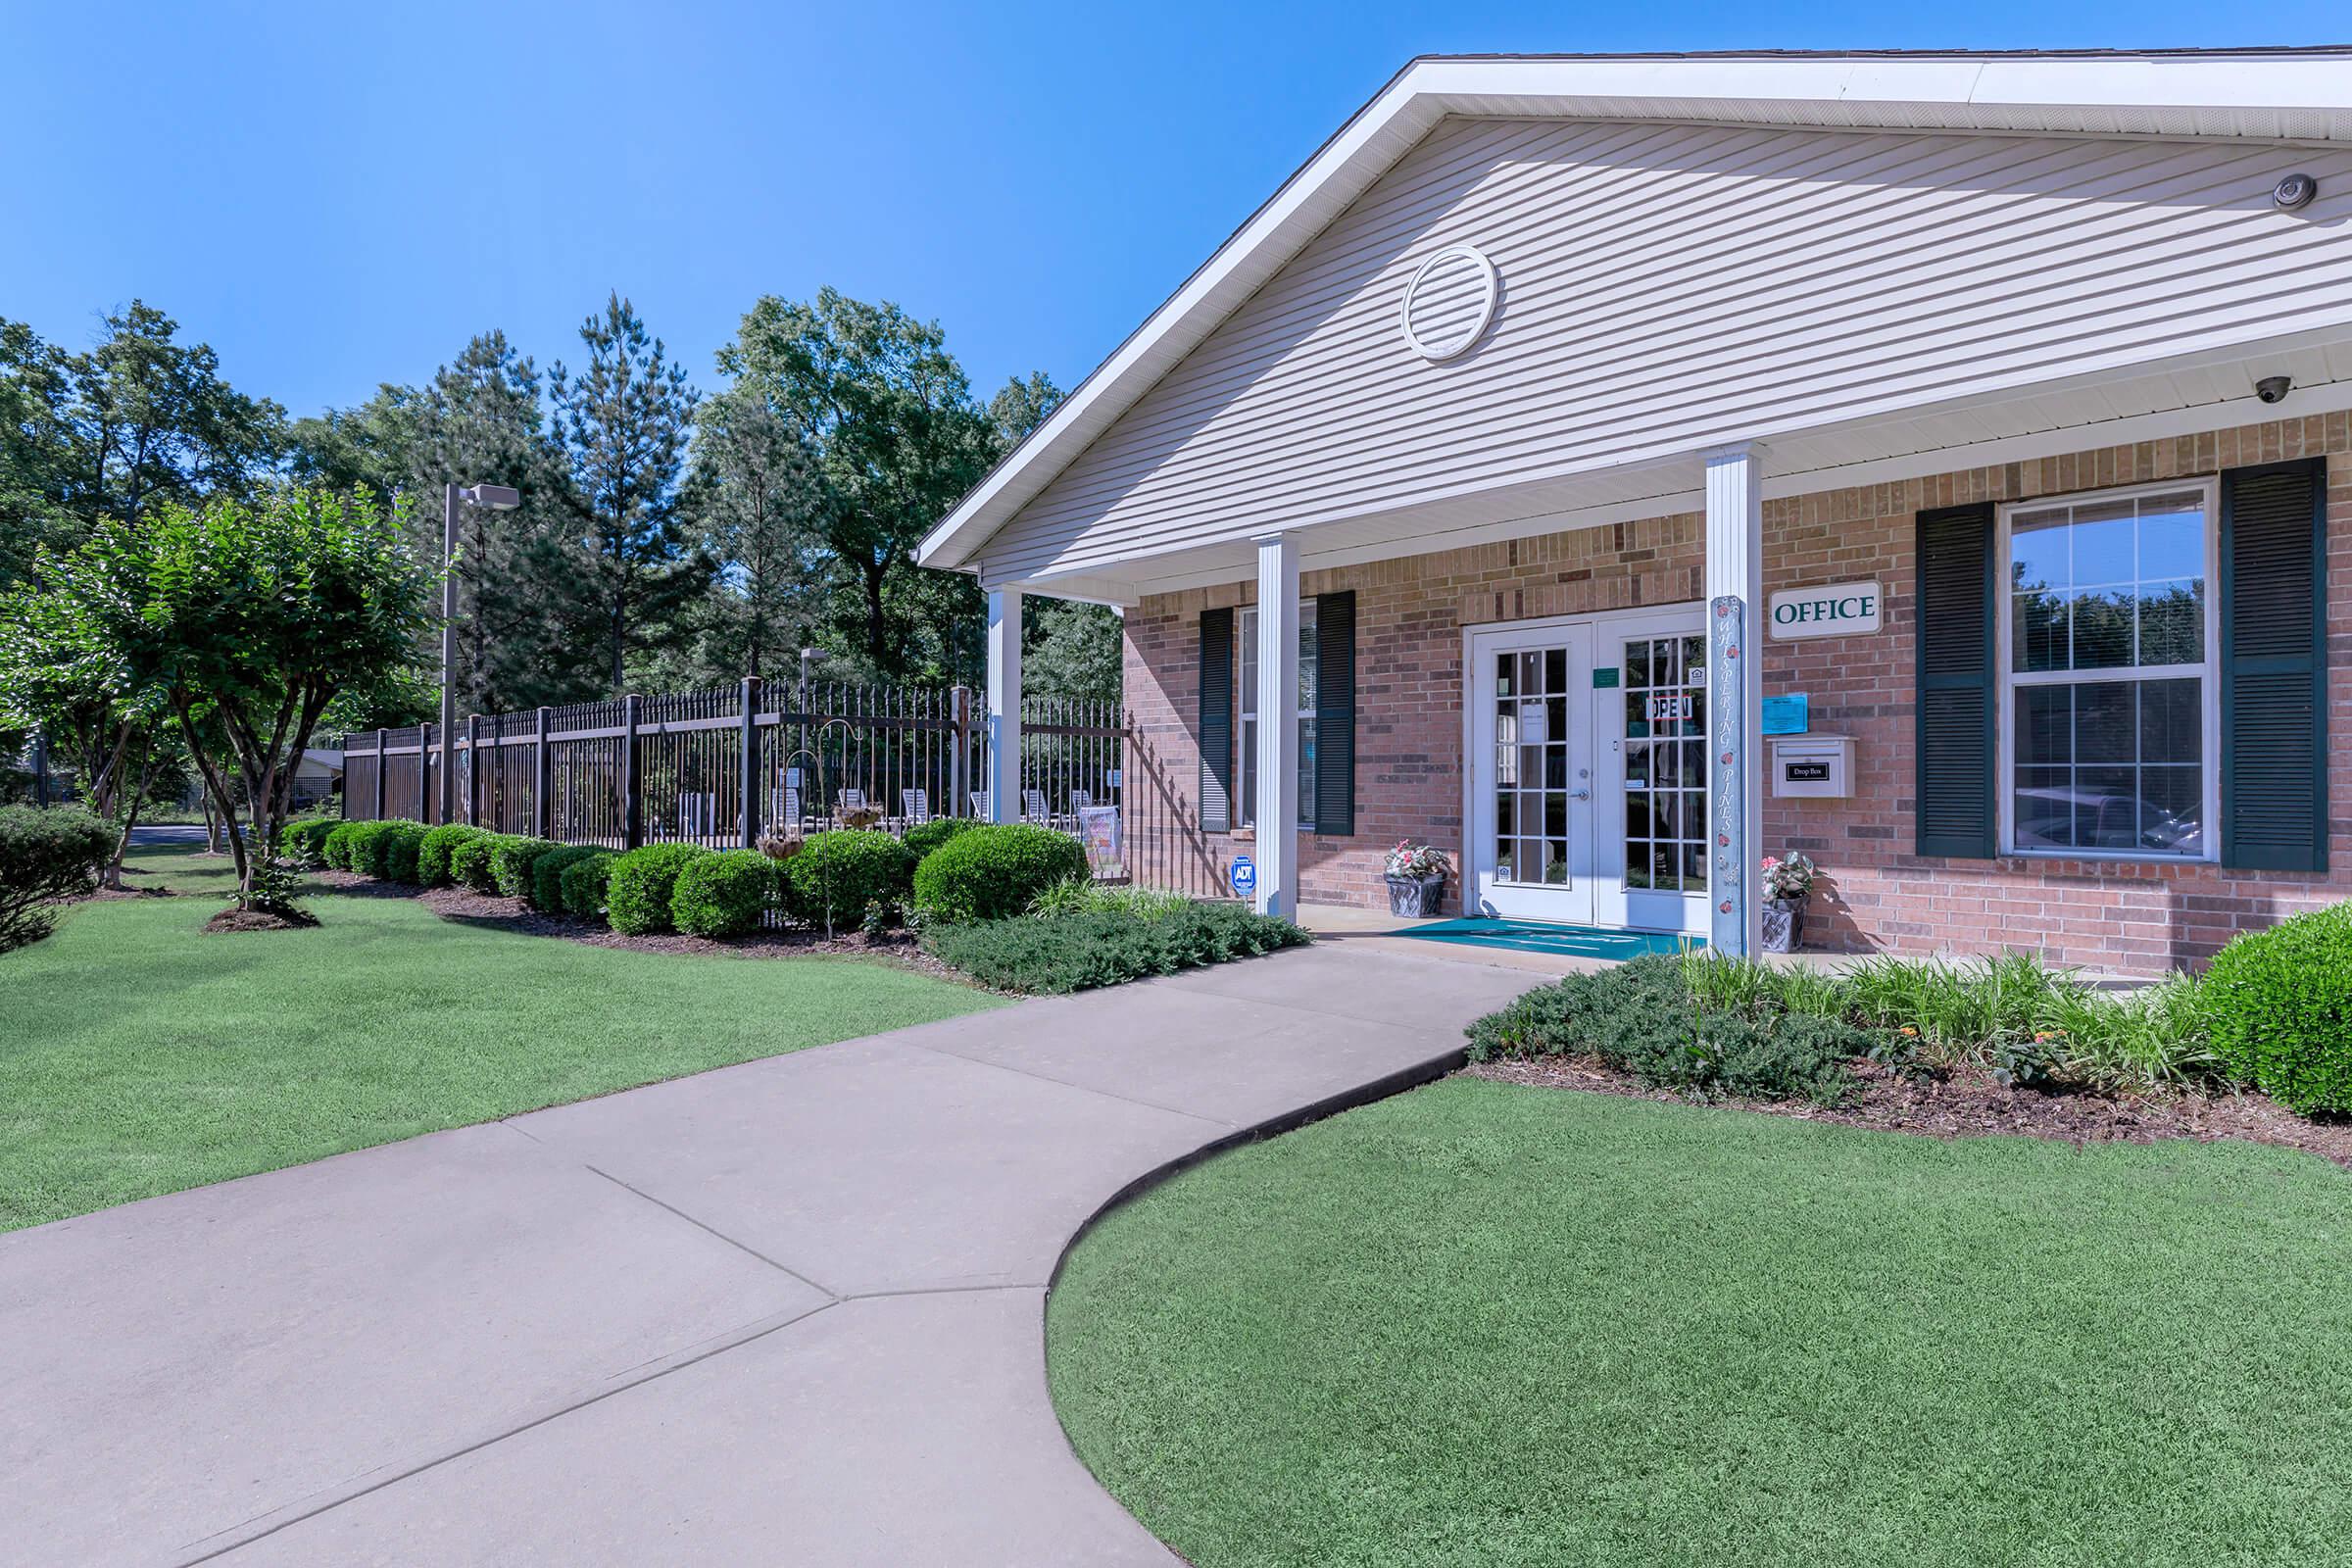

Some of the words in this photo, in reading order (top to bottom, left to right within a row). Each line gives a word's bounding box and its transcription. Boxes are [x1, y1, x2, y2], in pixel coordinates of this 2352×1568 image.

[1775, 596, 1876, 624] OFFICE
[1717, 618, 1735, 748] WHISPERING
[1793, 767, 1810, 777] Drop
[1718, 768, 1734, 831] PINES
[1235, 865, 1252, 880] ADT
